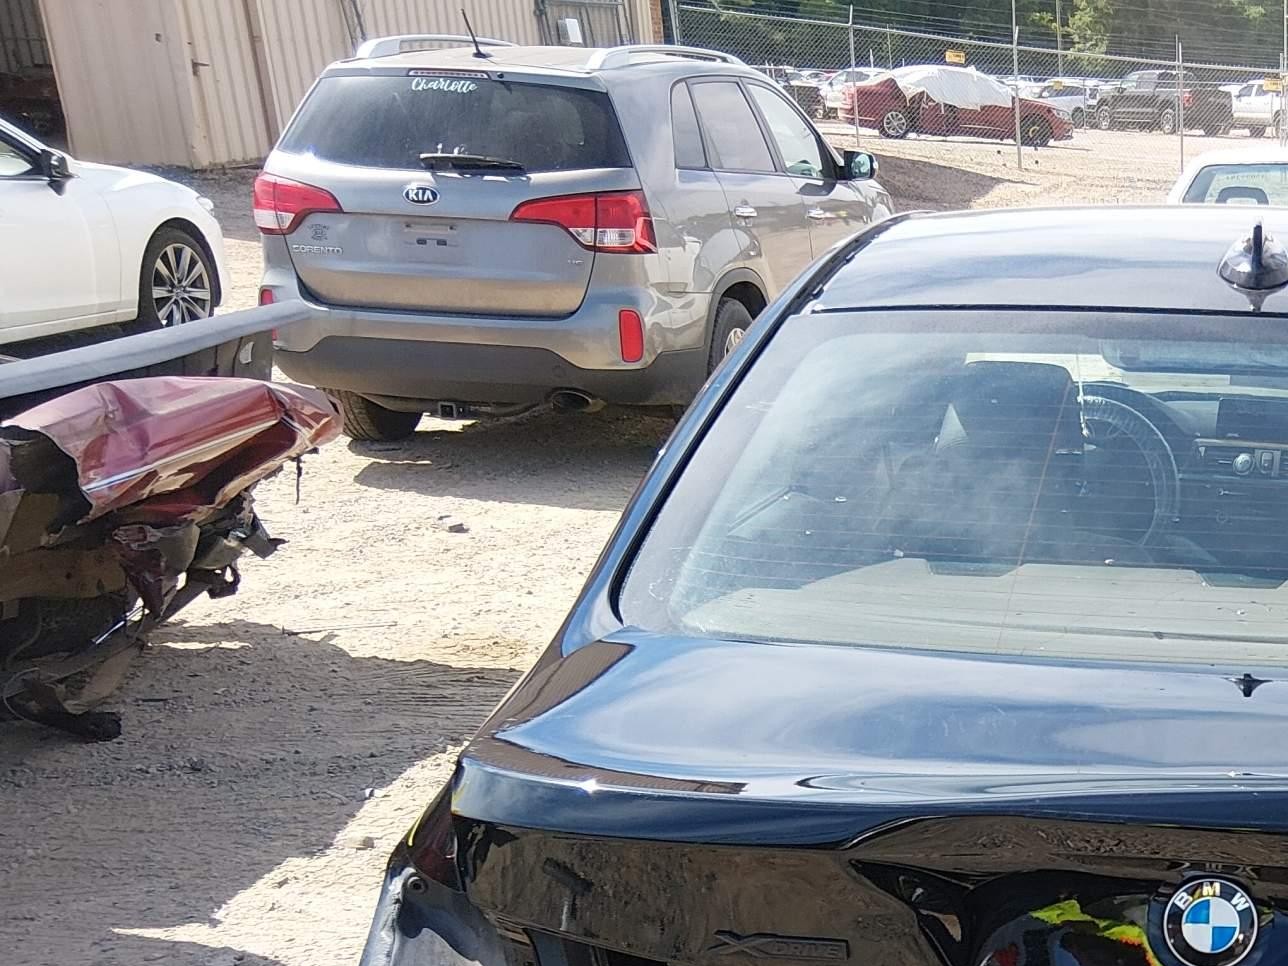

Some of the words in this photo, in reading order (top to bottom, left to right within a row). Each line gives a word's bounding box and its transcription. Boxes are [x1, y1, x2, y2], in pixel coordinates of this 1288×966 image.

[411, 76, 478, 94] Charlotte
[408, 189, 434, 202] KIA
[292, 244, 343, 255] SORENTO
[1174, 881, 1250, 912] BMW
